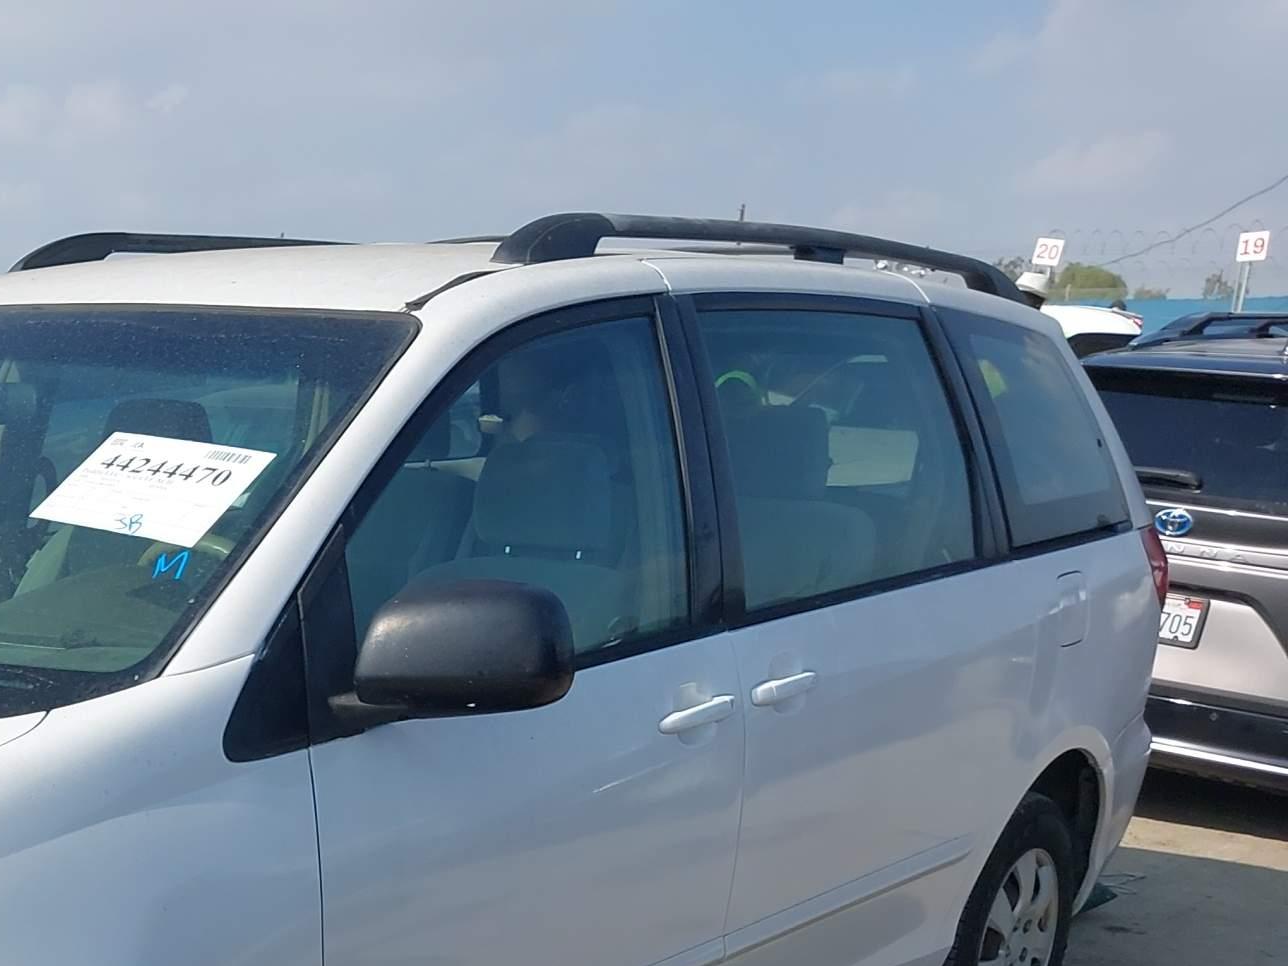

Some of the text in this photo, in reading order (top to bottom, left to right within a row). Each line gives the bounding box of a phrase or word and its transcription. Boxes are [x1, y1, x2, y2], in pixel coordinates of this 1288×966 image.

[1037, 243, 1059, 260] 20
[1240, 237, 1265, 255] 19
[101, 454, 232, 487] 44244470
[152, 550, 189, 580] M
